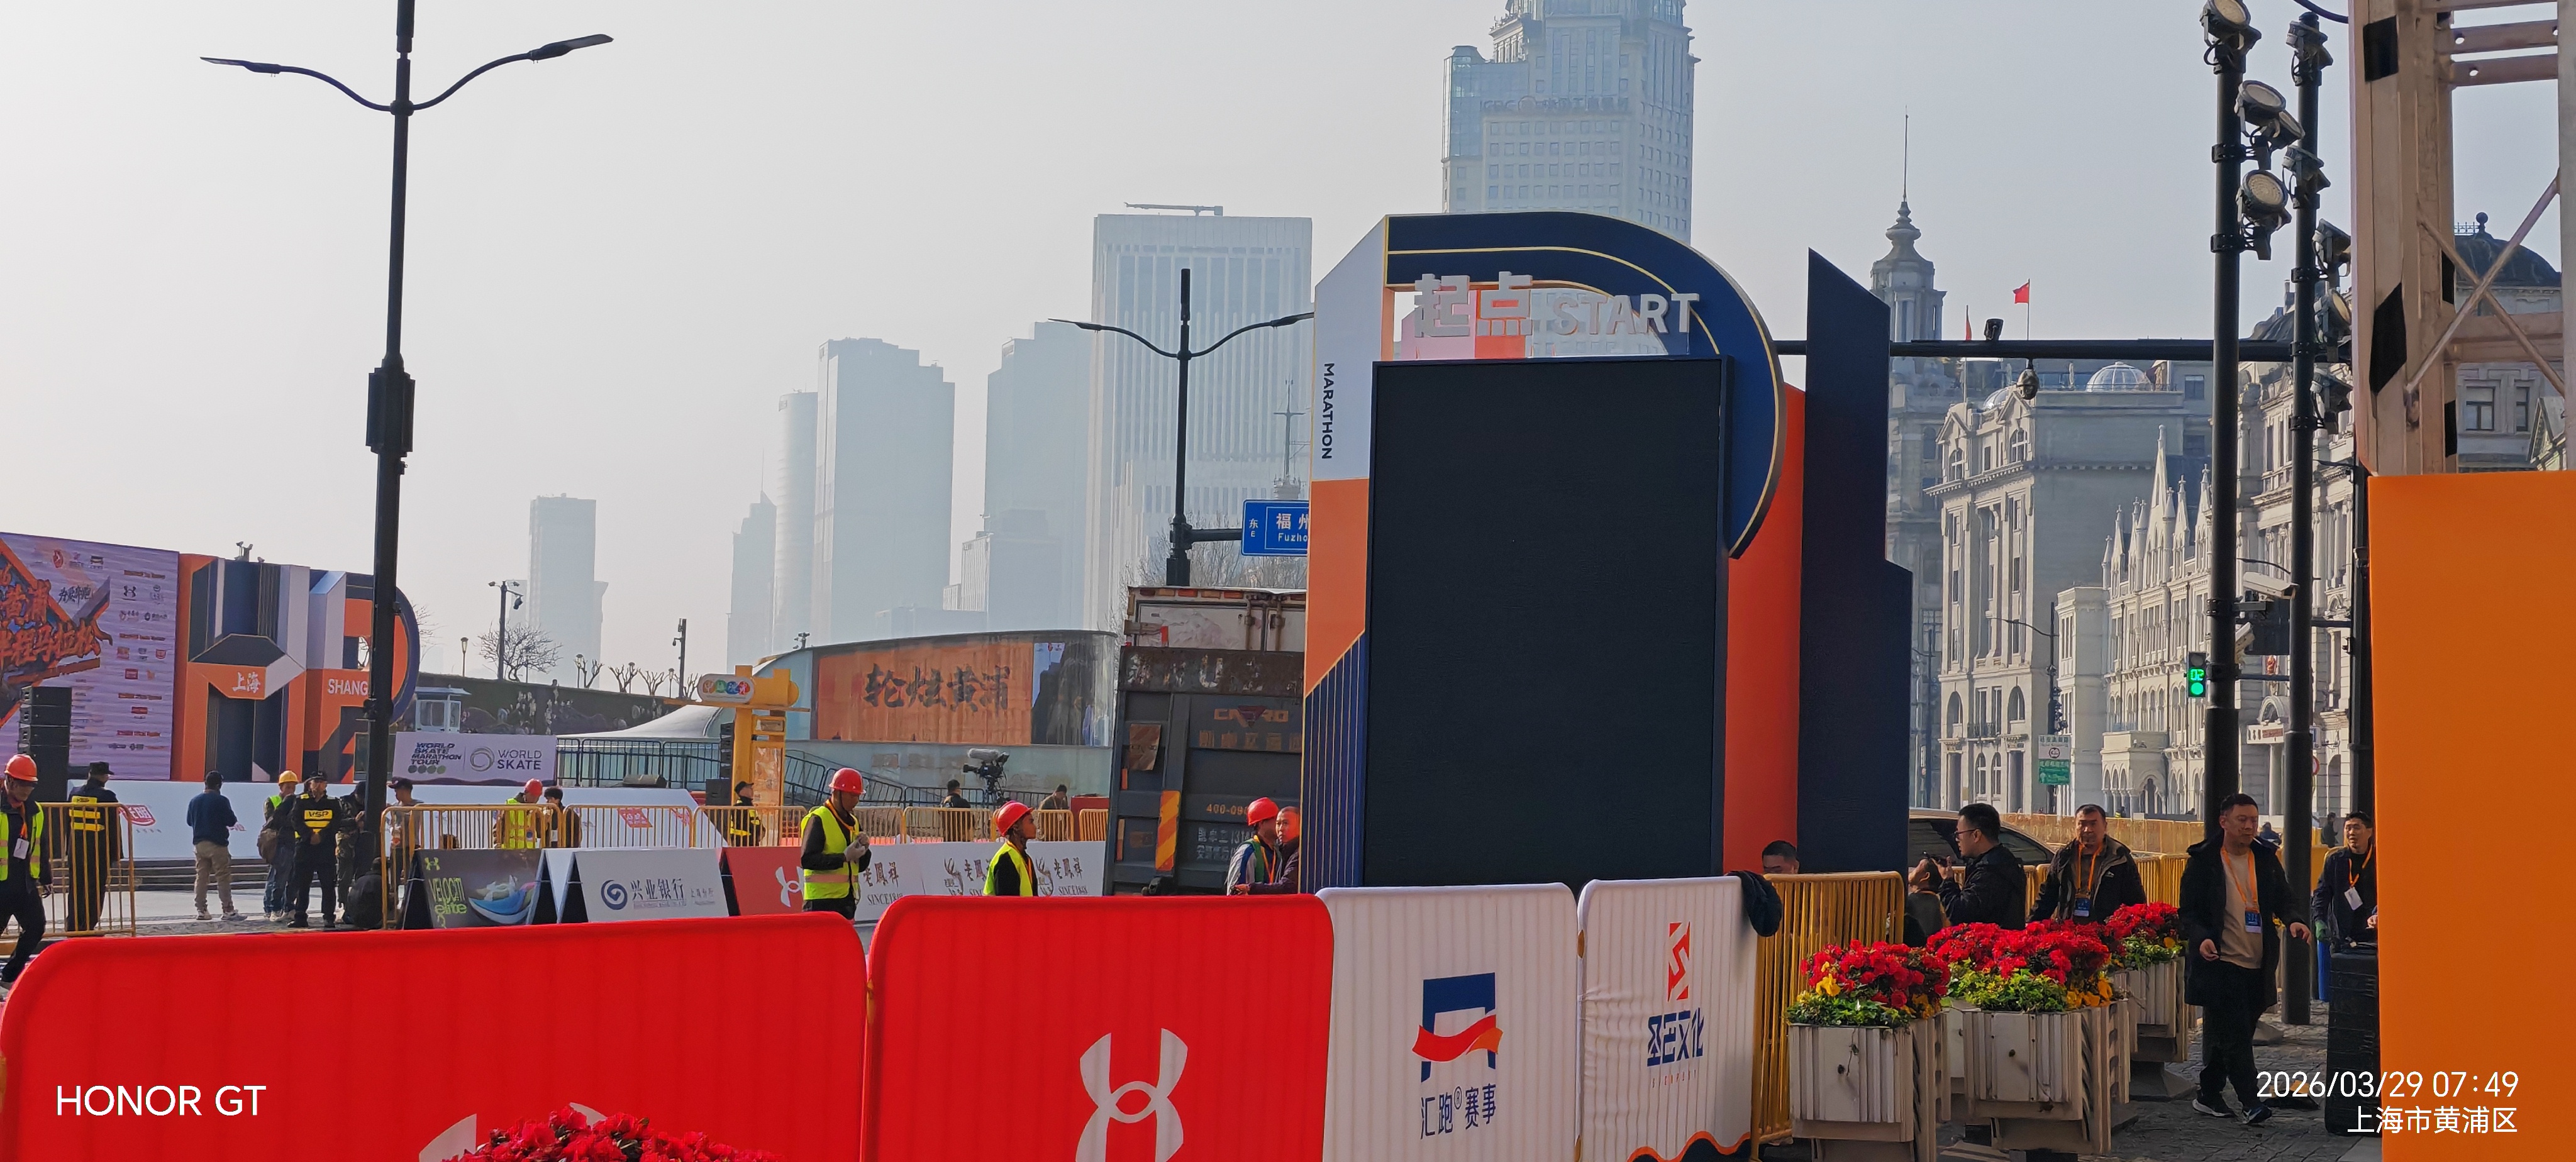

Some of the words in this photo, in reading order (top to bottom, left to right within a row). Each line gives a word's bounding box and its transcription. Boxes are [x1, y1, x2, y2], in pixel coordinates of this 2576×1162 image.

[1414, 271, 1533, 338] 起点
[1552, 293, 1699, 335] START
[1321, 363, 1335, 460] MARATHON
[1248, 518, 1258, 529] 东
[1276, 513, 1309, 529] 福州
[2190, 668, 2205, 681] 02
[232, 672, 261, 694] 上海
[497, 749, 542, 759] WORLD
[497, 760, 541, 770] SKATE
[630, 878, 684, 900] 兴业银行
